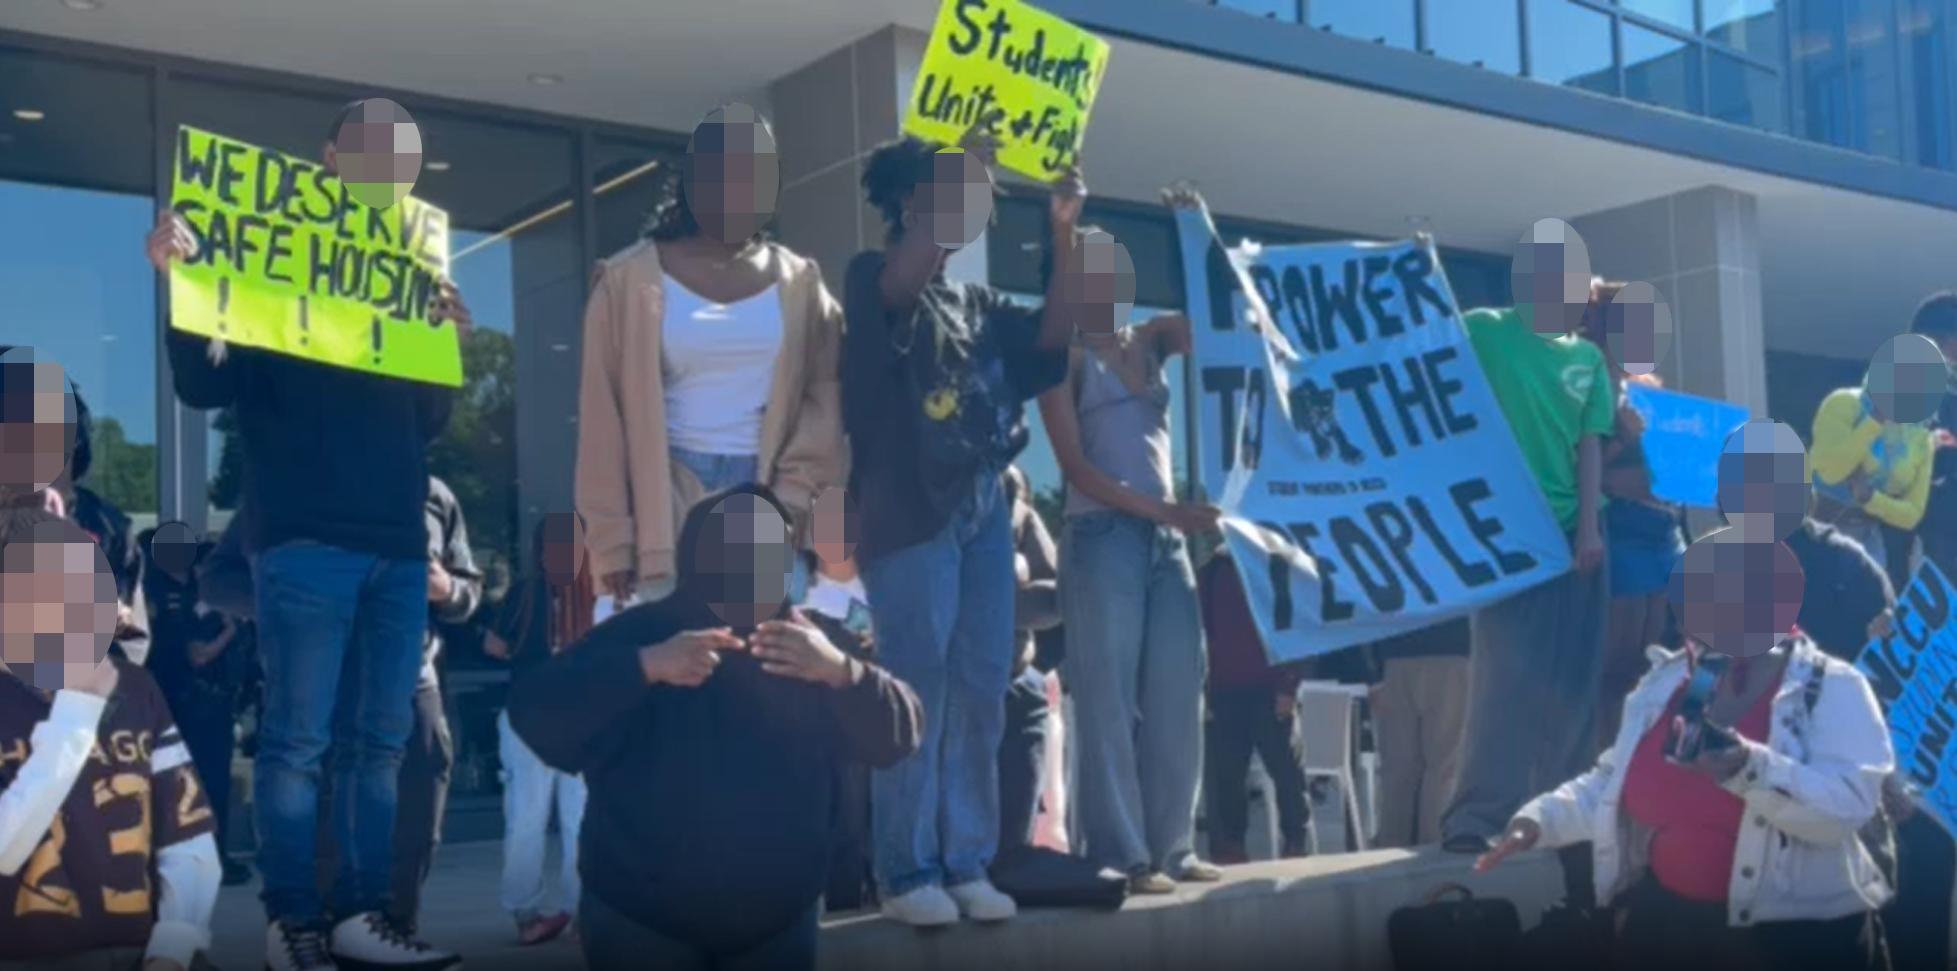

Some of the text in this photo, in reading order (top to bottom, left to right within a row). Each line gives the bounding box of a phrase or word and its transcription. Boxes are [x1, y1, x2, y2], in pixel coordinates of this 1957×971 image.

[917, 74, 1005, 136] Unite
[178, 128, 247, 206] WE
[171, 200, 294, 284] SAFE
[1332, 347, 1477, 459] THE
[1255, 477, 1539, 631] PEOPLE
